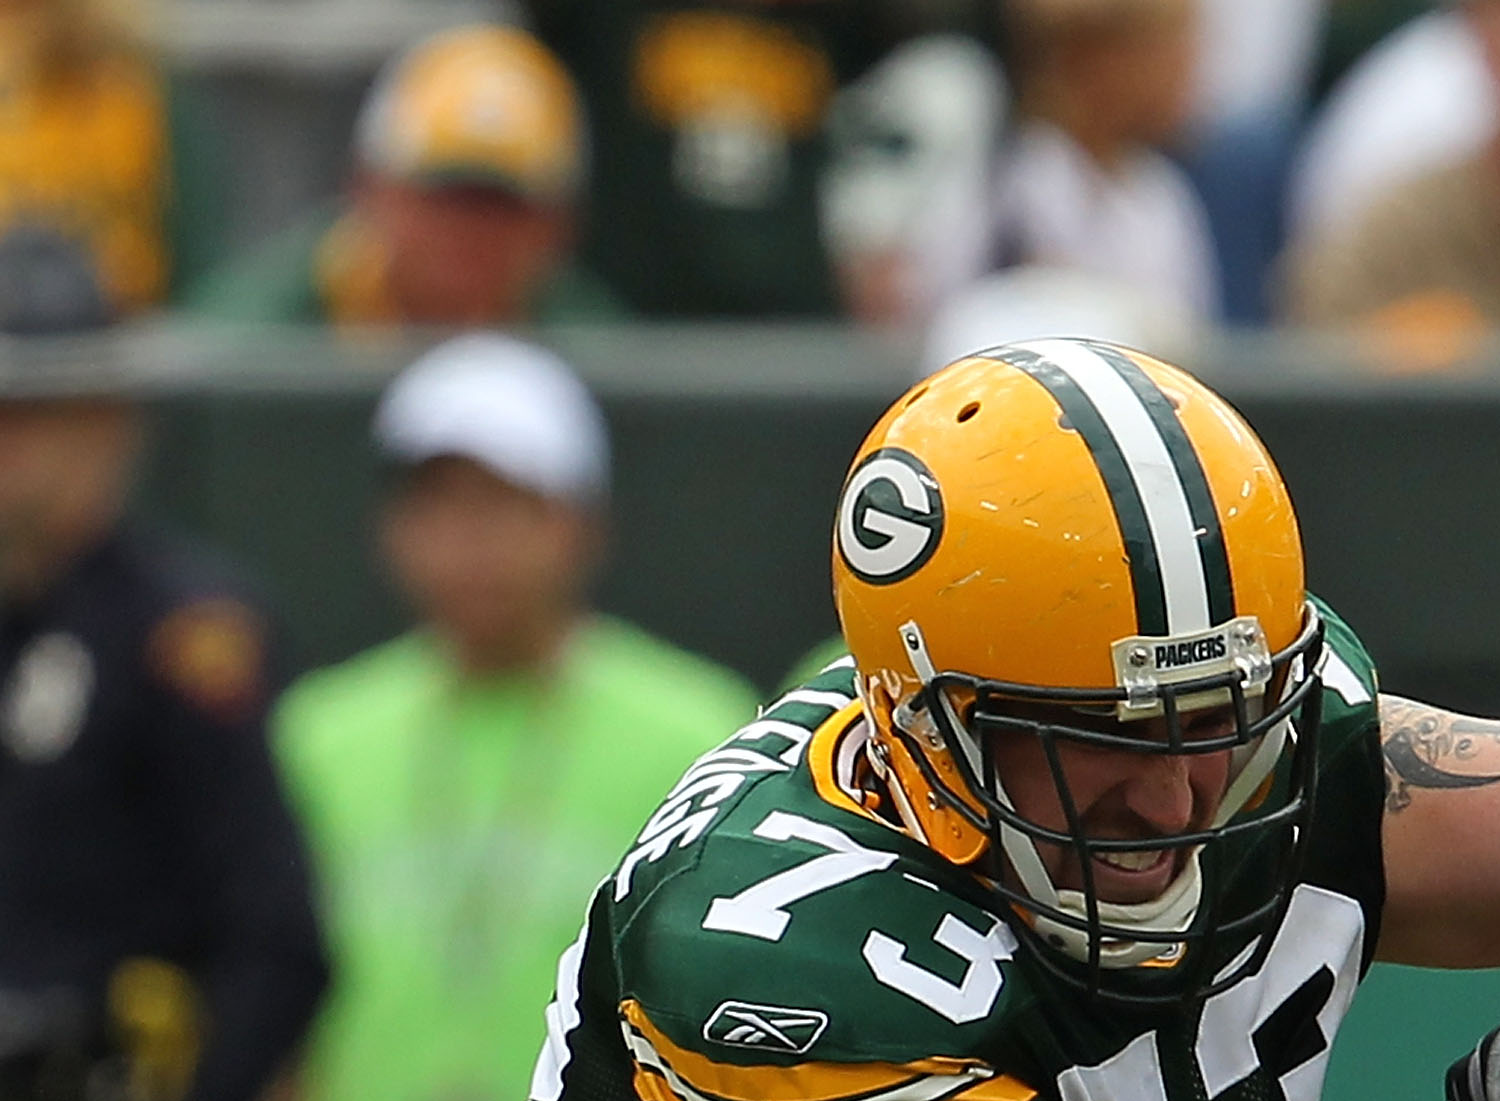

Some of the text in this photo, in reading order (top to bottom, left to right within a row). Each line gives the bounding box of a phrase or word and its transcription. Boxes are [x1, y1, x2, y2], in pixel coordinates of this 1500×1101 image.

[840, 458, 932, 576] G
[1155, 634, 1227, 669] PACKERS
[702, 810, 1020, 1024] 73
